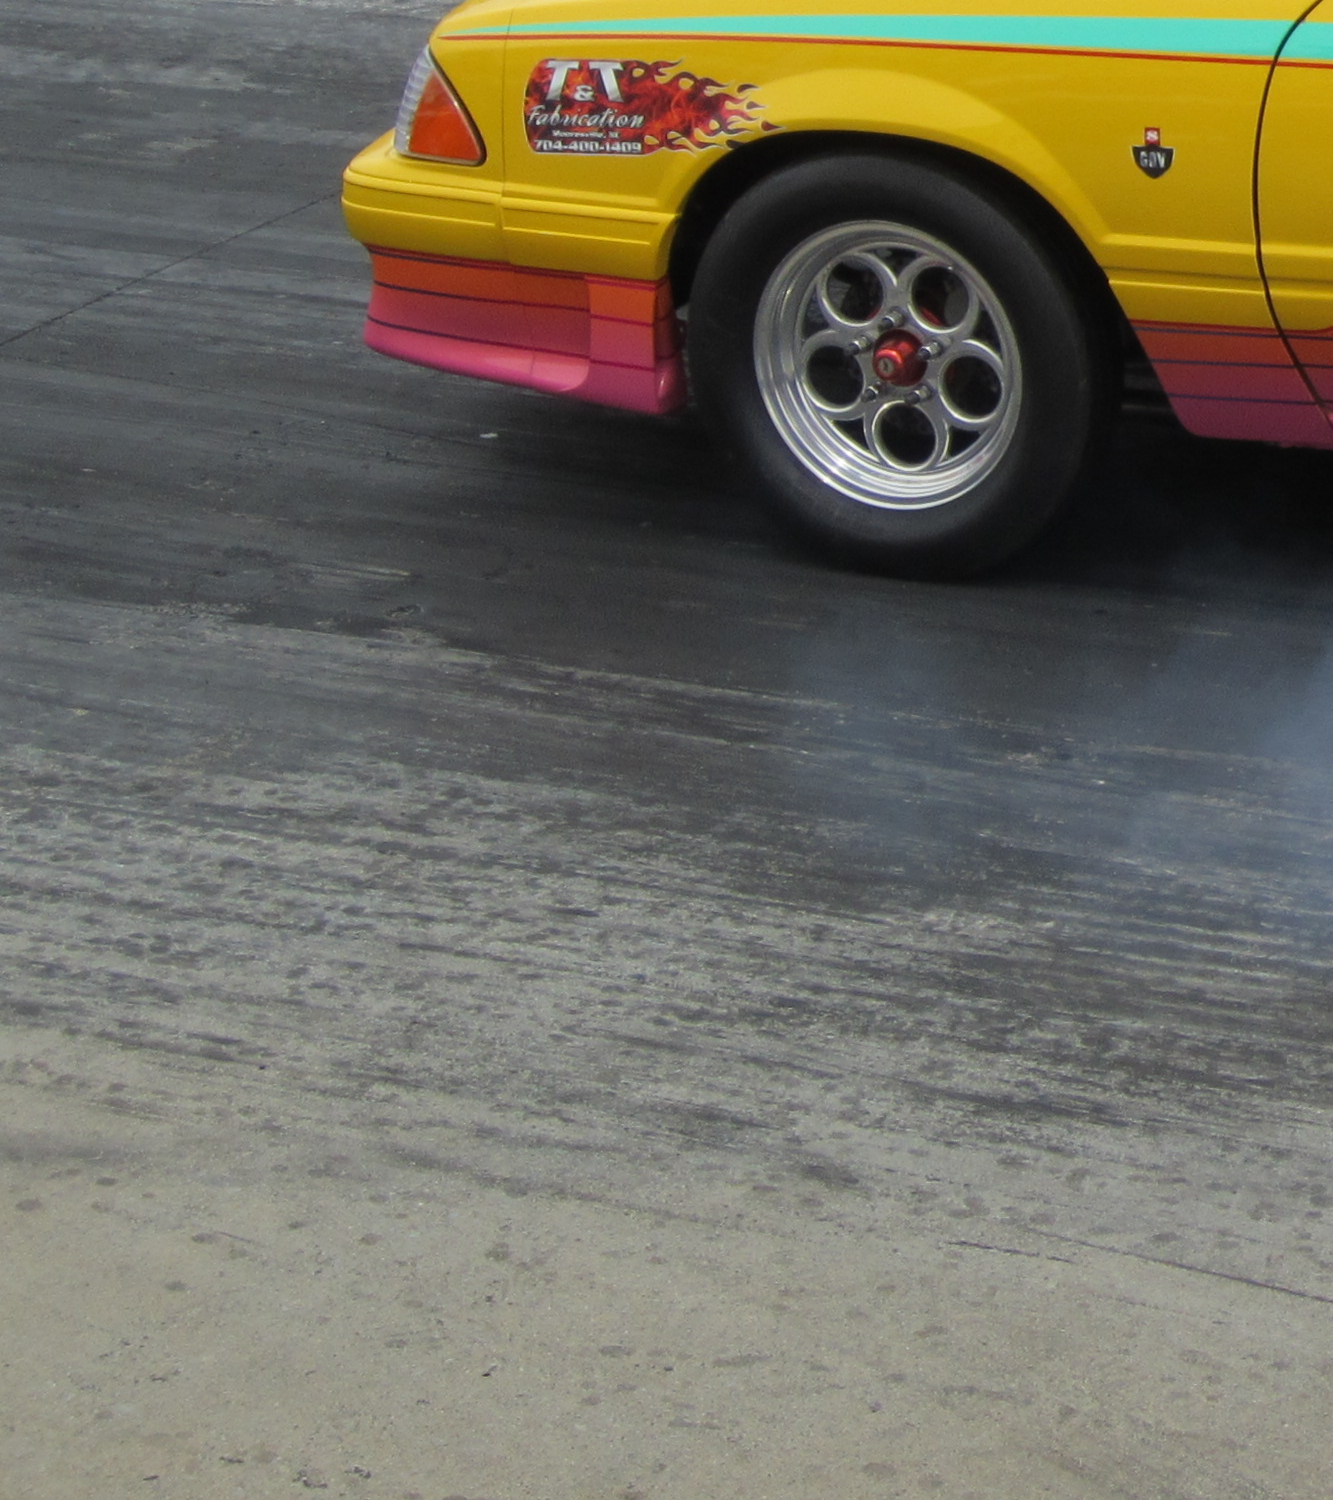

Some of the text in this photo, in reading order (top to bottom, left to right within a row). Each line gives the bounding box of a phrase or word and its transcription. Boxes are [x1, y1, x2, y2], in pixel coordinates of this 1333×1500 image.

[546, 60, 625, 103] T & T
[528, 103, 646, 130] Fabrication
[534, 139, 643, 154] 704-400-1409
